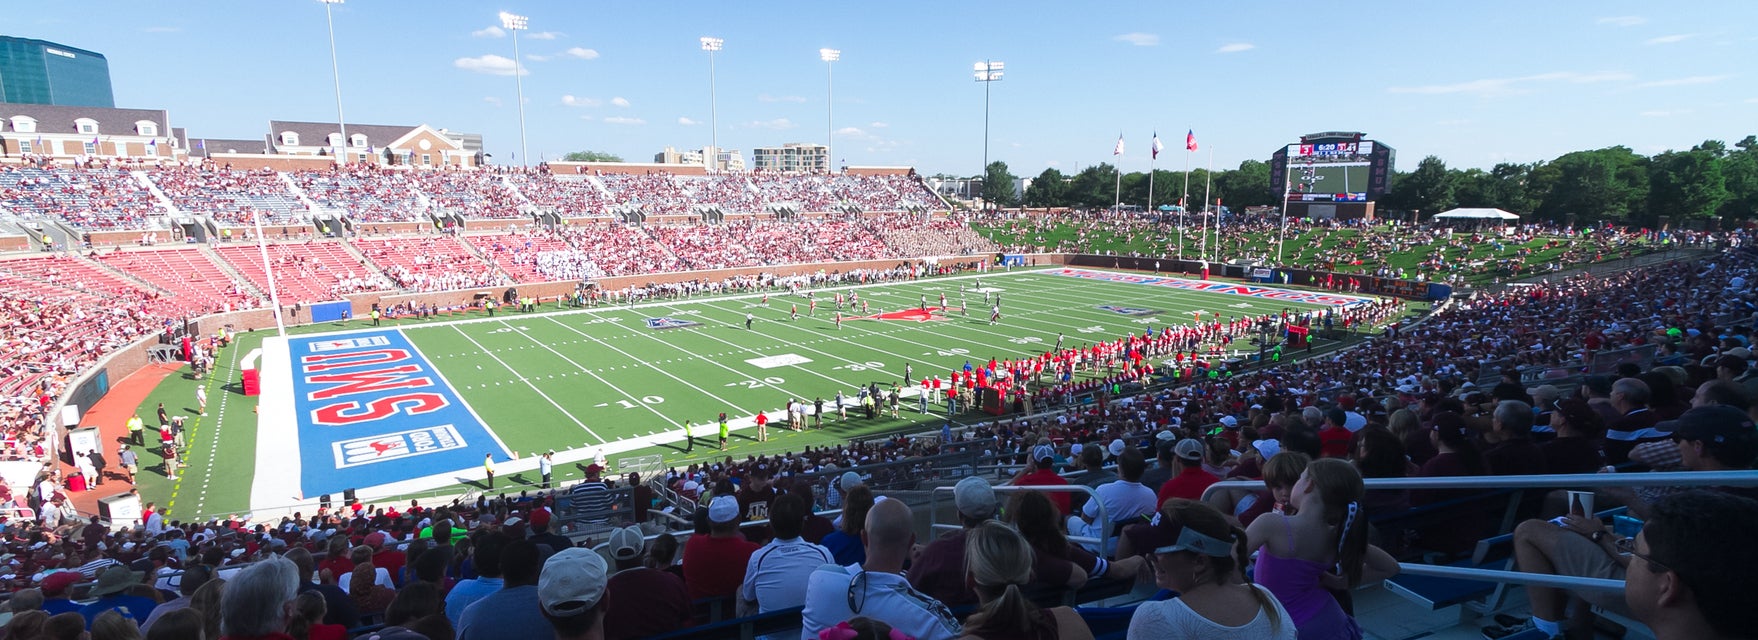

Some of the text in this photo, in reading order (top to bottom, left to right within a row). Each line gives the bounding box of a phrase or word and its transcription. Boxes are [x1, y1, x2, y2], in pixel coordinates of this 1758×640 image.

[301, 349, 450, 426] SMU
[739, 377, 786, 389] 20
[616, 395, 665, 409] 10
